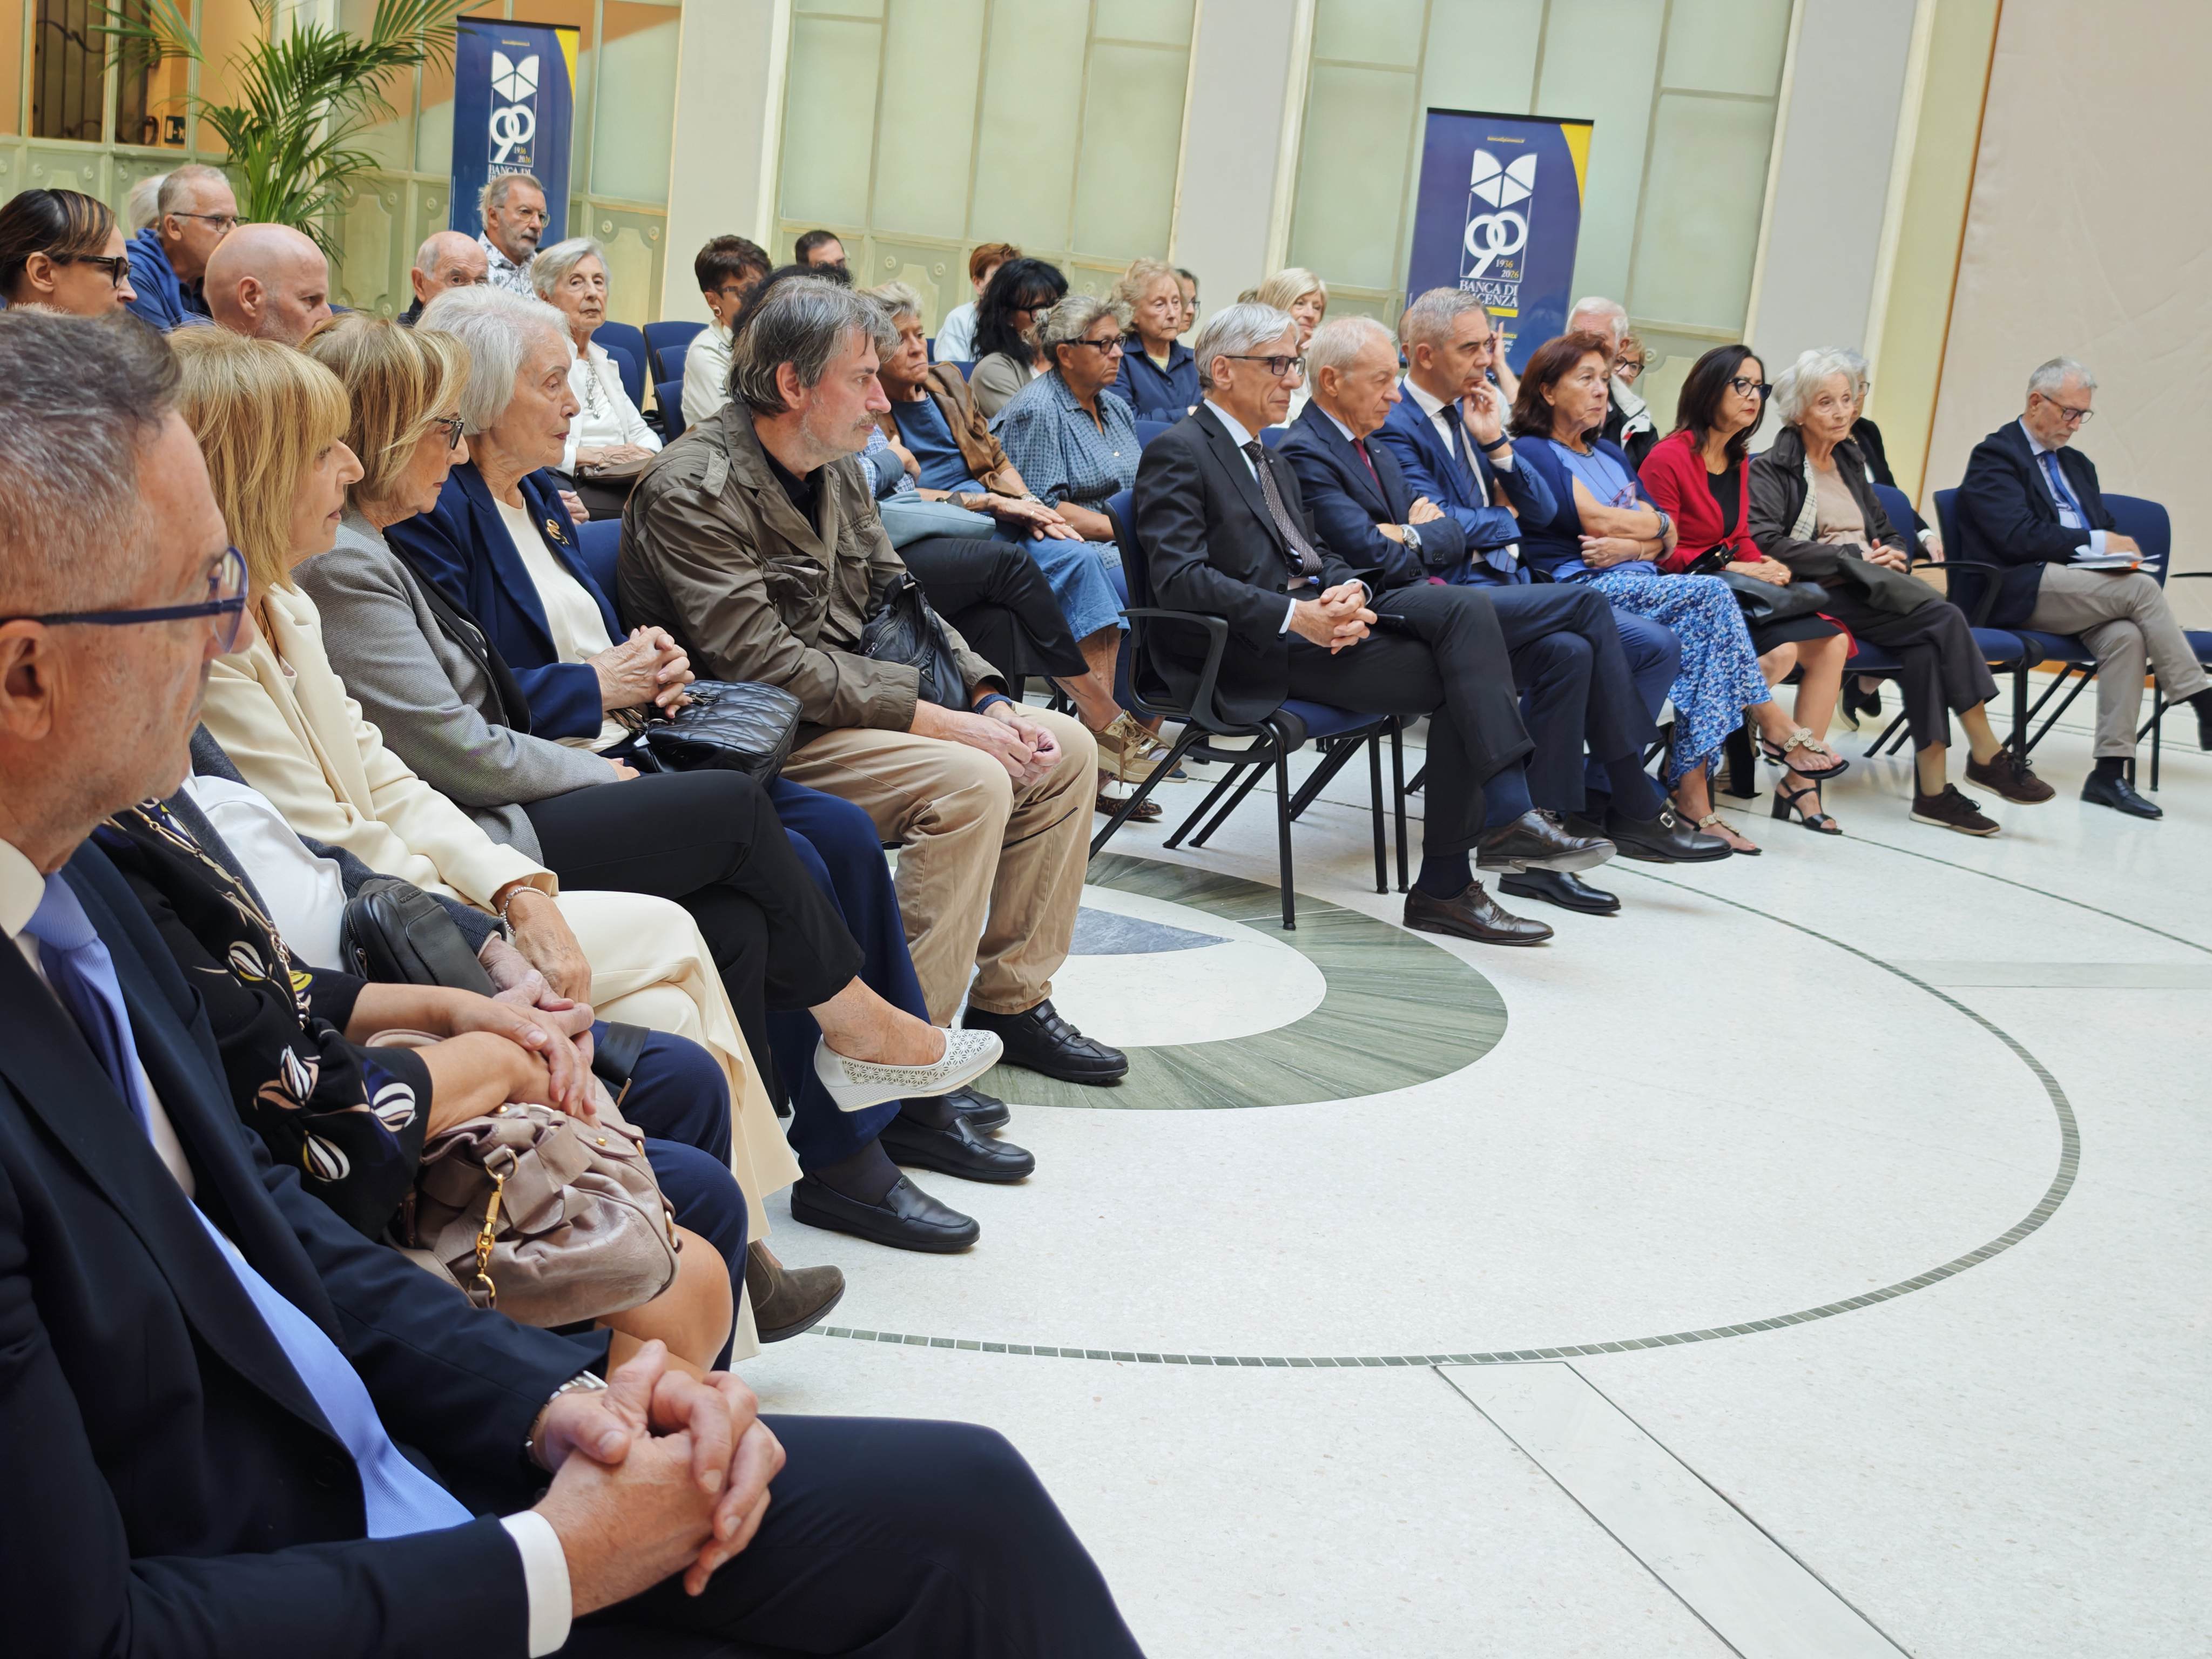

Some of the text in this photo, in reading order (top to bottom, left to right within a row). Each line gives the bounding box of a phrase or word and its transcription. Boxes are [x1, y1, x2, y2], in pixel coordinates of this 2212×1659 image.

[489, 104, 535, 164] 90
[1464, 211, 1527, 279] 90
[1495, 259, 1513, 268] 1936
[1501, 269, 1519, 279] 2026
[1459, 280, 1519, 296] BANCA DI
